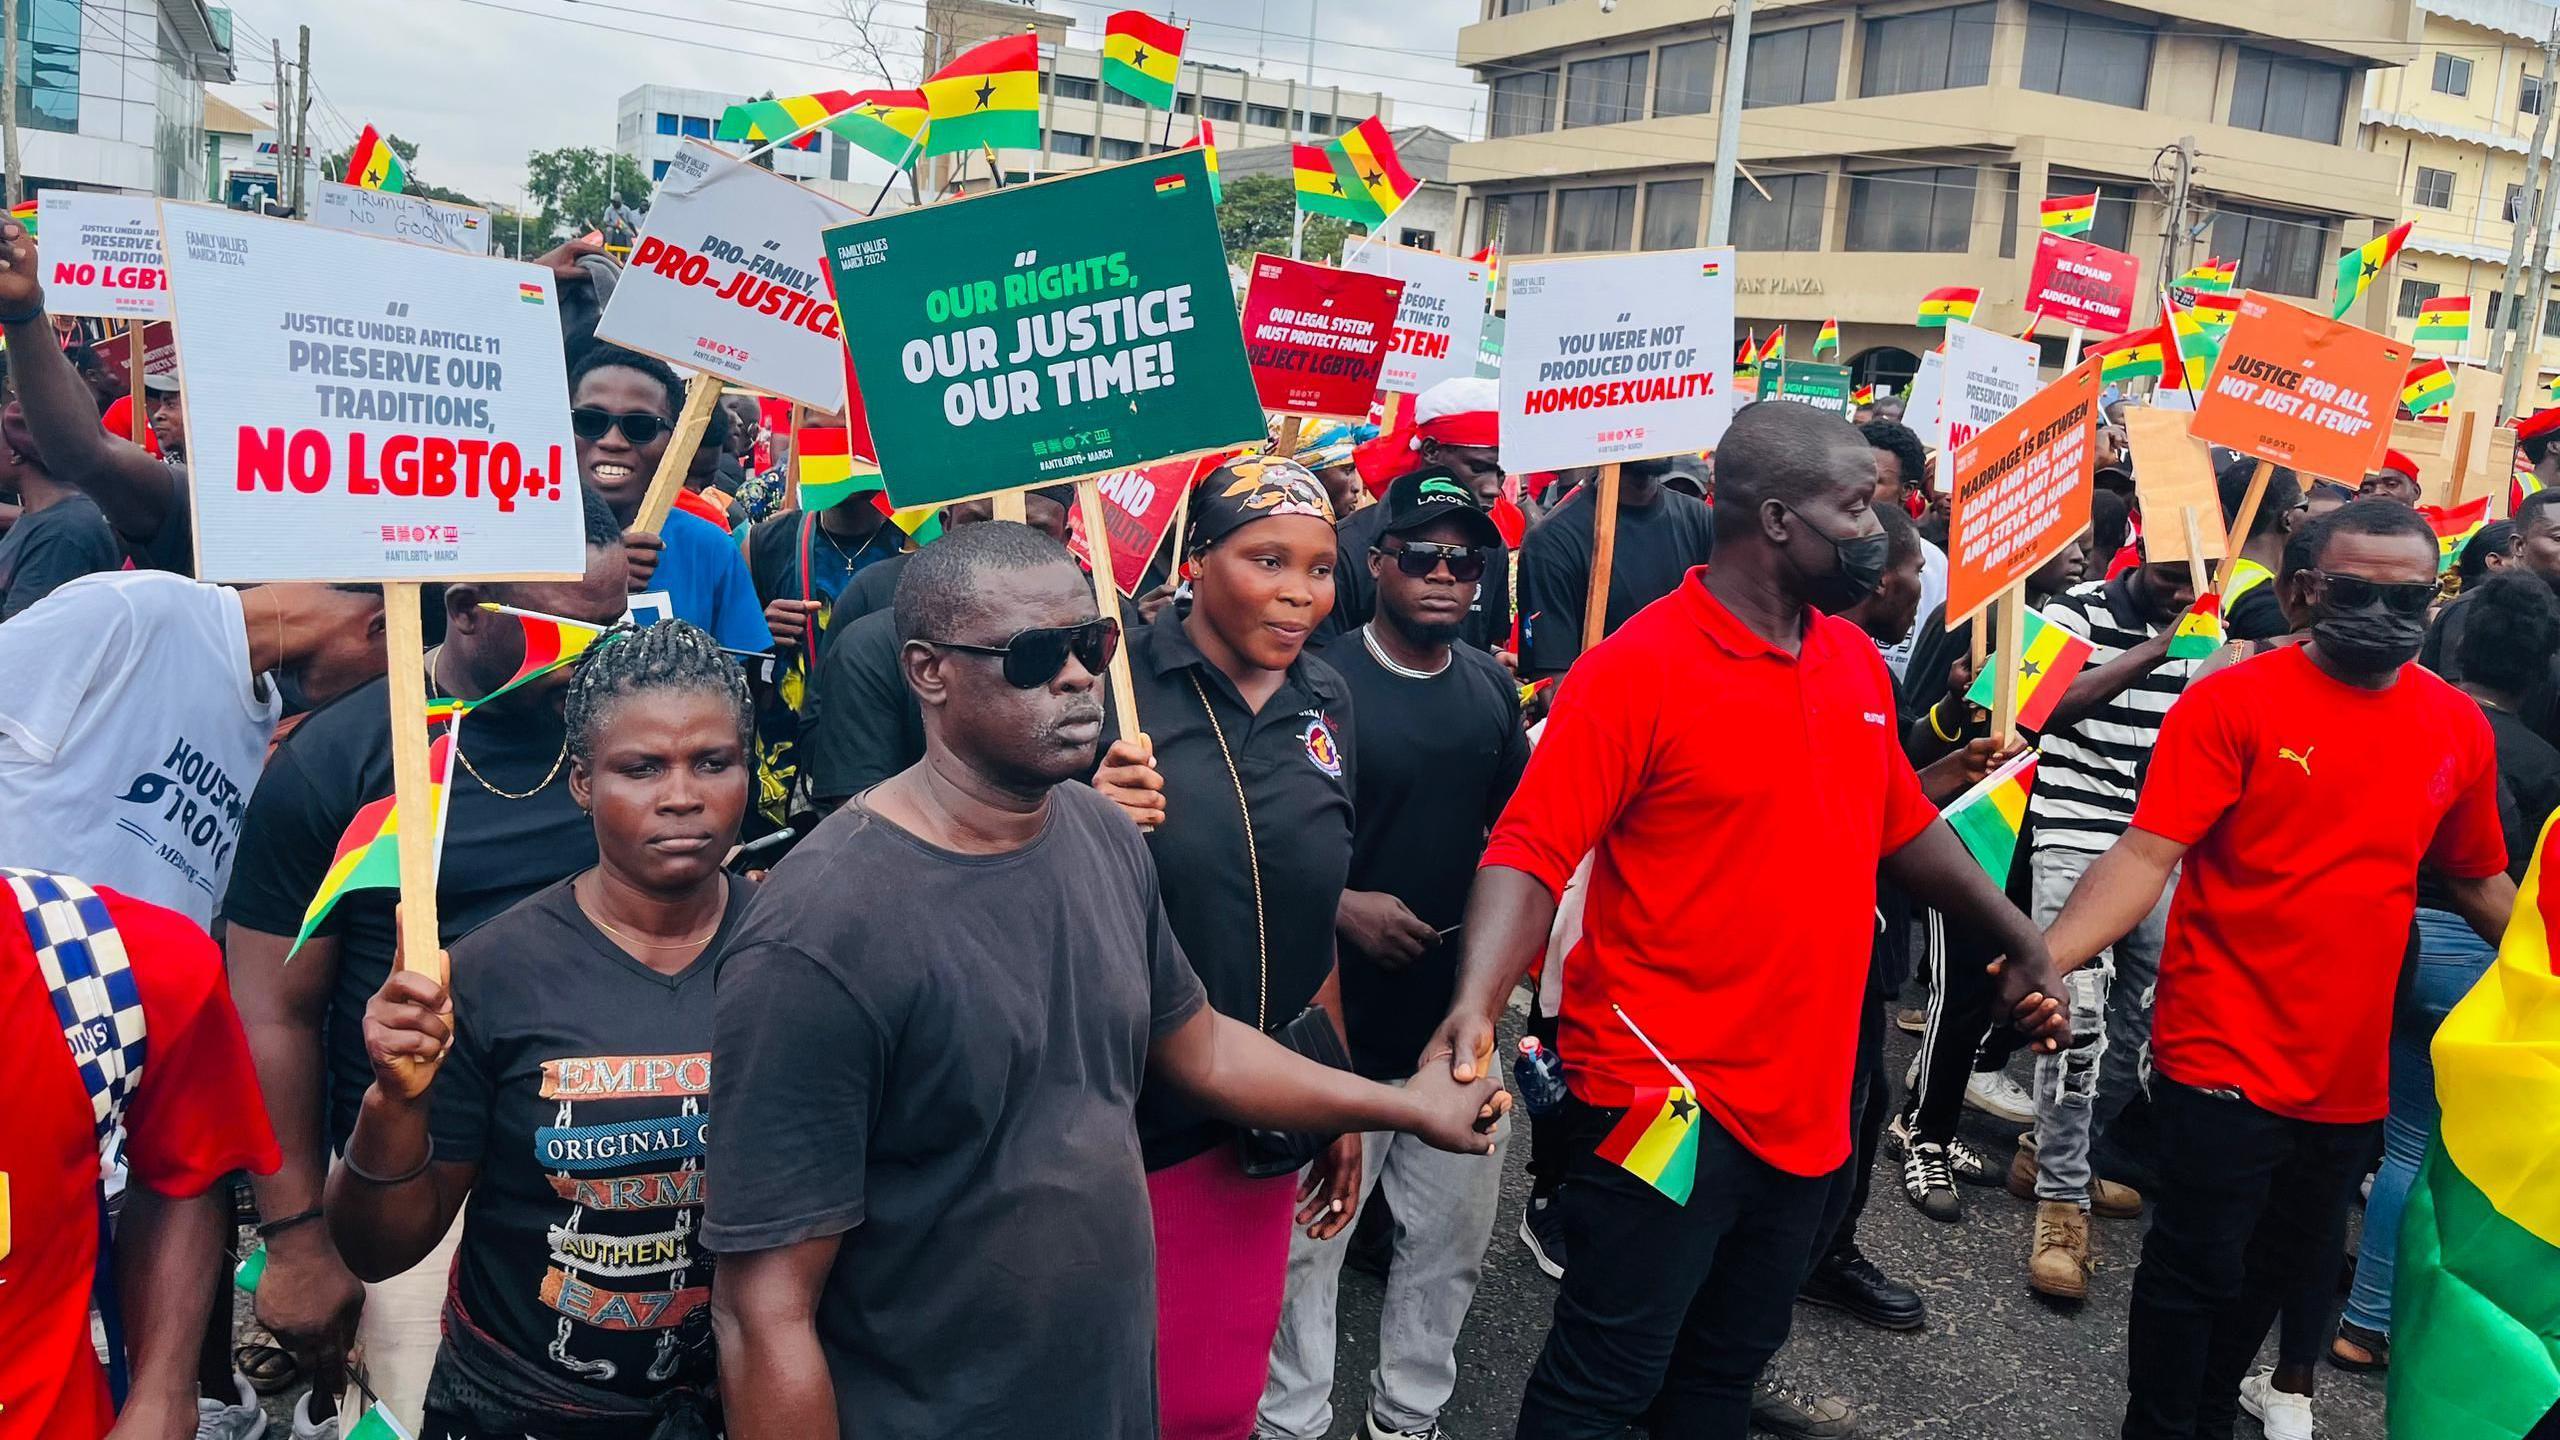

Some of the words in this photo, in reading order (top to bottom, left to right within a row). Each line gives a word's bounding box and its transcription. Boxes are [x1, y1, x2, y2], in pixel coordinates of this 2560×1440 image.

[80, 224, 112, 234] JUSTICE
[115, 226, 142, 236] UNDER
[350, 209, 375, 224] NO
[82, 234, 152, 250] PRESERVE
[186, 231, 216, 249] FAMILY
[216, 236, 248, 253] VALUES
[188, 247, 217, 262] MARCH
[218, 250, 245, 266] 2024
[838, 243, 862, 260] FAMILY
[861, 238, 888, 254] VALUES
[54, 262, 96, 286] NO
[700, 235, 819, 296] PRO-FAMILY,
[841, 256, 864, 271] MARCH
[864, 252, 886, 266] 2024
[2056, 258, 2073, 272] WE
[2073, 262, 2112, 282] DEMAND
[926, 280, 998, 324] OUR
[1004, 252, 1138, 308] RIGHTS,
[1770, 278, 1824, 295] PLAZA
[2048, 269, 2123, 303] URGENT
[1405, 294, 1446, 312] PEOPLE
[2038, 288, 2082, 307] JUDICIAL
[2082, 300, 2120, 318] ACTION!
[280, 312, 354, 338] JUSTICE
[358, 320, 416, 345] UNDER
[420, 329, 482, 353] ARTICLE
[485, 338, 500, 354] 11
[902, 326, 1000, 384] OUR
[1008, 284, 1194, 364] JUSTICE
[1270, 308, 1295, 324] OUR
[1294, 312, 1328, 330] LEGAL
[1331, 317, 1374, 336] SYSTEM
[1409, 312, 1436, 326] TIME
[1436, 316, 1450, 328] TO
[1256, 324, 1291, 342] MUST
[1289, 332, 1339, 350] PROTECT
[1338, 338, 1378, 354] FAMILY
[1387, 326, 1450, 359] STEN!
[1559, 332, 1594, 356] YOU
[1599, 328, 1646, 352] WERE
[1650, 326, 1684, 348] NOT
[289, 340, 440, 386] PRESERVE
[446, 358, 502, 392] OUR
[1248, 344, 1310, 370] REJECT
[1539, 354, 1633, 382] PRODUCED
[1636, 351, 1672, 372] OUT
[1674, 348, 1697, 368] OF
[943, 370, 1042, 427] OUR
[1047, 340, 1176, 406] TIME!
[1524, 372, 1714, 416] HOMOSEXUALITY.
[1766, 381, 1802, 394] ENUGH
[1803, 384, 1840, 397] WAITING
[1966, 384, 2002, 406] PRESERVE
[2216, 375, 2258, 402] NOT
[2256, 390, 2304, 417] JUST
[2299, 404, 2314, 422] A
[2228, 354, 2302, 390] JUSTICE
[2299, 376, 2336, 403] FOR
[2334, 388, 2369, 418] ALL,
[316, 384, 496, 434] TRADITIONS,
[1810, 396, 1843, 410] NOW!
[1088, 449, 1114, 462] MARCH
[1960, 446, 2022, 503] MARRIAGE
[2024, 436, 2035, 459] IS
[2036, 399, 2088, 448] BETWEEN
[236, 425, 332, 494] NO
[348, 432, 562, 512] LGBTQ+!
[1960, 484, 1998, 526] ADAM
[1999, 466, 2024, 496] AND
[2052, 422, 2086, 460] HAWA
[1960, 512, 1988, 548] AND
[2050, 444, 2084, 482] ADAM
[1961, 534, 1990, 568] AND
[1991, 504, 2028, 546] STEVE
[2029, 494, 2045, 518] OR
[2047, 468, 2080, 505] HAWA
[1983, 542, 2011, 572] AND
[2012, 504, 2062, 554] MARIAM.
[434, 550, 458, 560] MARCH
[557, 1058, 712, 1094] EMPO
[547, 1128, 688, 1160] ORIGINAL
[556, 1277, 675, 1328] EA7
